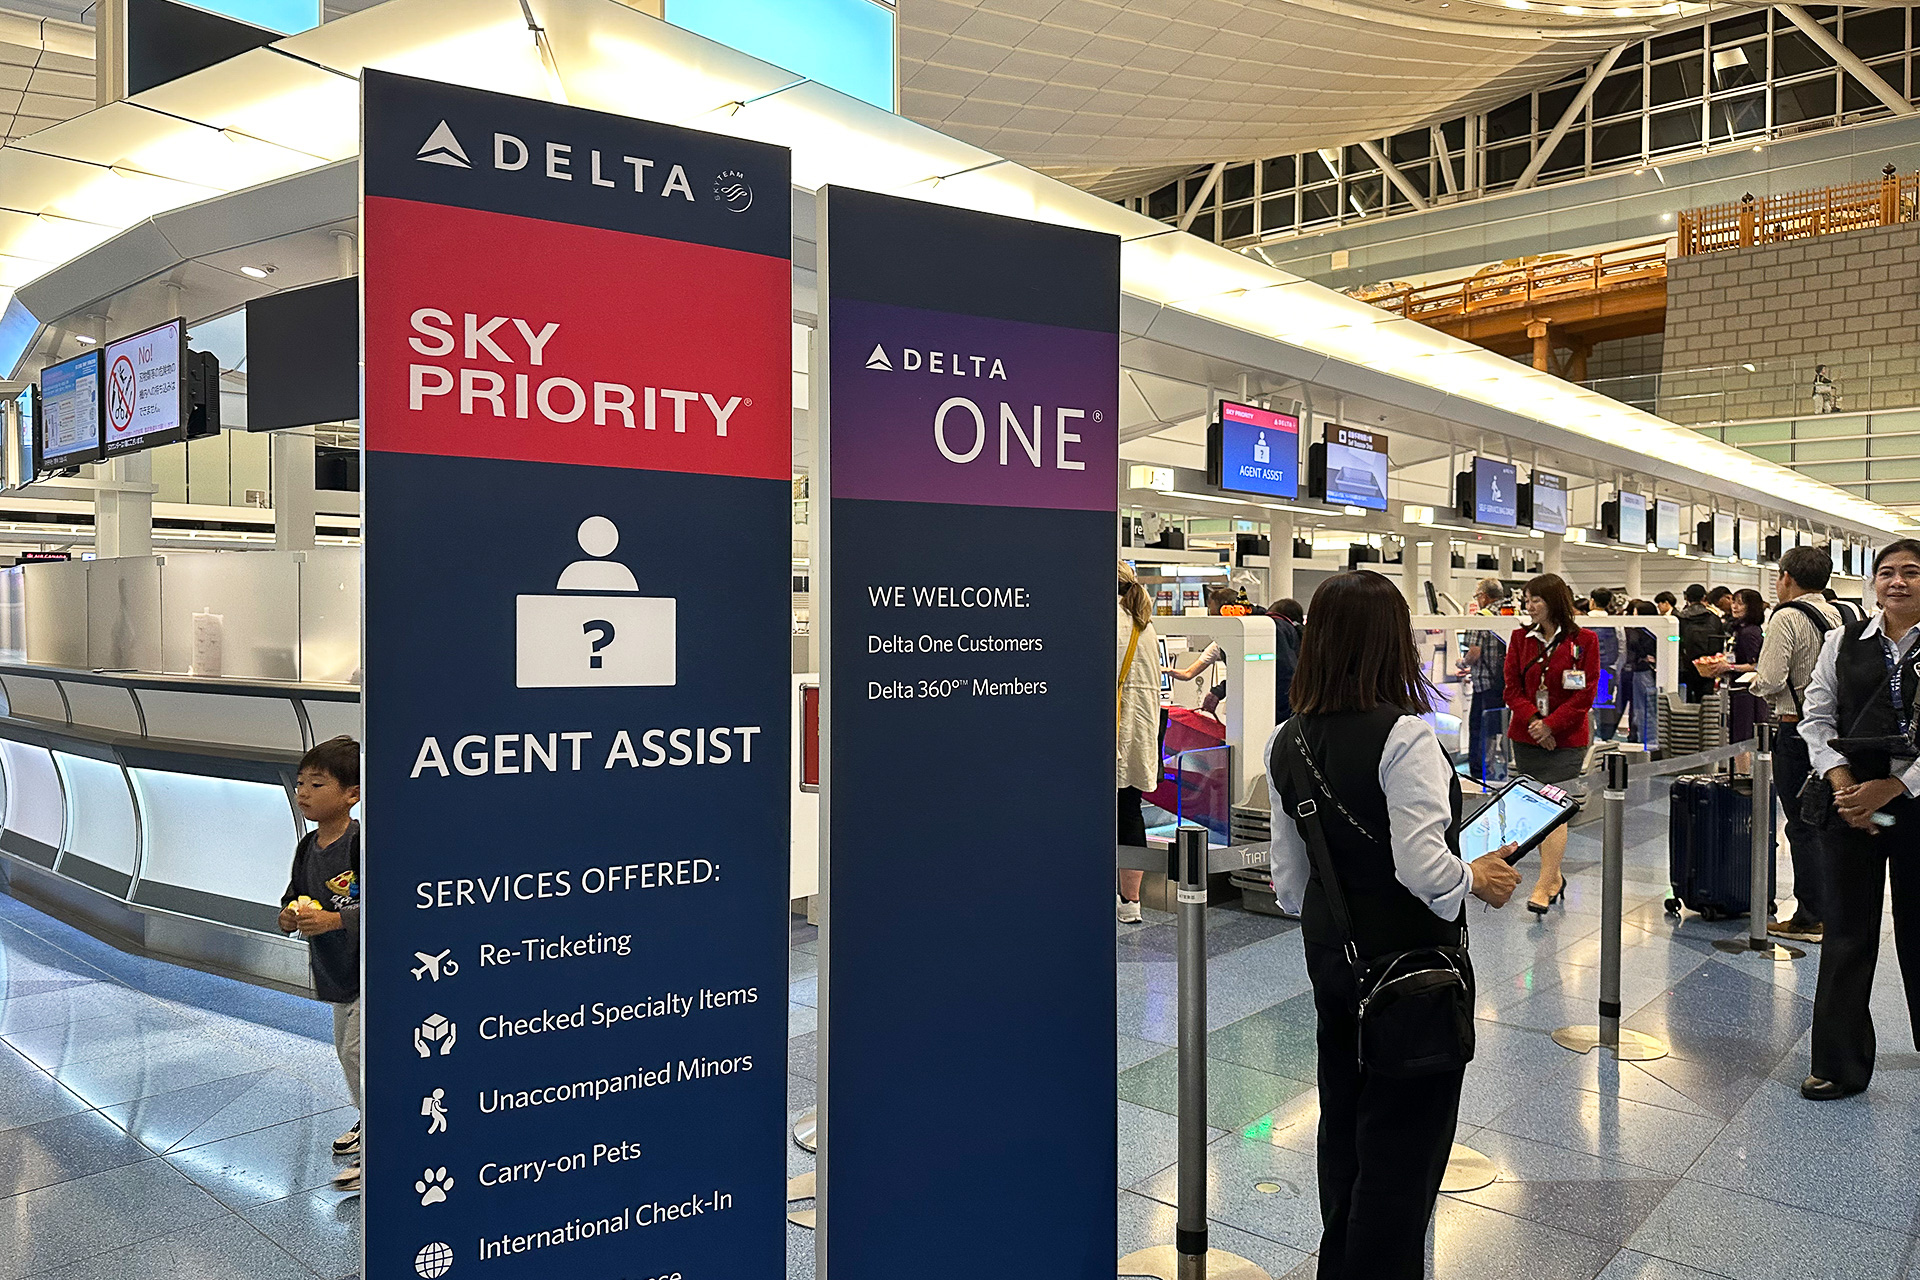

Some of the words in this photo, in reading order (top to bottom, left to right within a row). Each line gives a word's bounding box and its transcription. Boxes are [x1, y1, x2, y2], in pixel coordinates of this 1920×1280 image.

[495, 133, 695, 201] DELTA
[713, 170, 744, 201] SKYTEAM
[409, 308, 560, 365] SKY
[138, 343, 153, 365] No!
[904, 349, 1006, 380] DELTA
[1239, 465, 1262, 478] AGENT
[1262, 469, 1283, 481] ASSIST
[868, 587, 905, 606] WE
[913, 587, 1029, 607] WELCOME:
[869, 635, 913, 653] Delta
[919, 635, 953, 652] One
[958, 635, 1042, 652] Customers
[869, 681, 913, 699] Delta
[973, 677, 1047, 696] Members
[410, 732, 592, 778] AGENT
[605, 727, 760, 769] ASSIST
[1245, 851, 1267, 865] TIAT
[417, 871, 570, 908] SERVICES
[582, 859, 719, 893] OFFERED:
[481, 932, 631, 966] Re-Ticketing
[480, 1005, 584, 1039] Checked
[592, 993, 693, 1028] Specialty
[700, 986, 757, 1009] Items
[480, 1062, 670, 1113] Unaccompanied
[678, 1054, 752, 1081] Minors
[480, 1154, 585, 1186] Carry-on
[594, 1141, 640, 1166] Pets
[480, 1208, 628, 1260] International
[636, 1190, 731, 1226] Check-In
